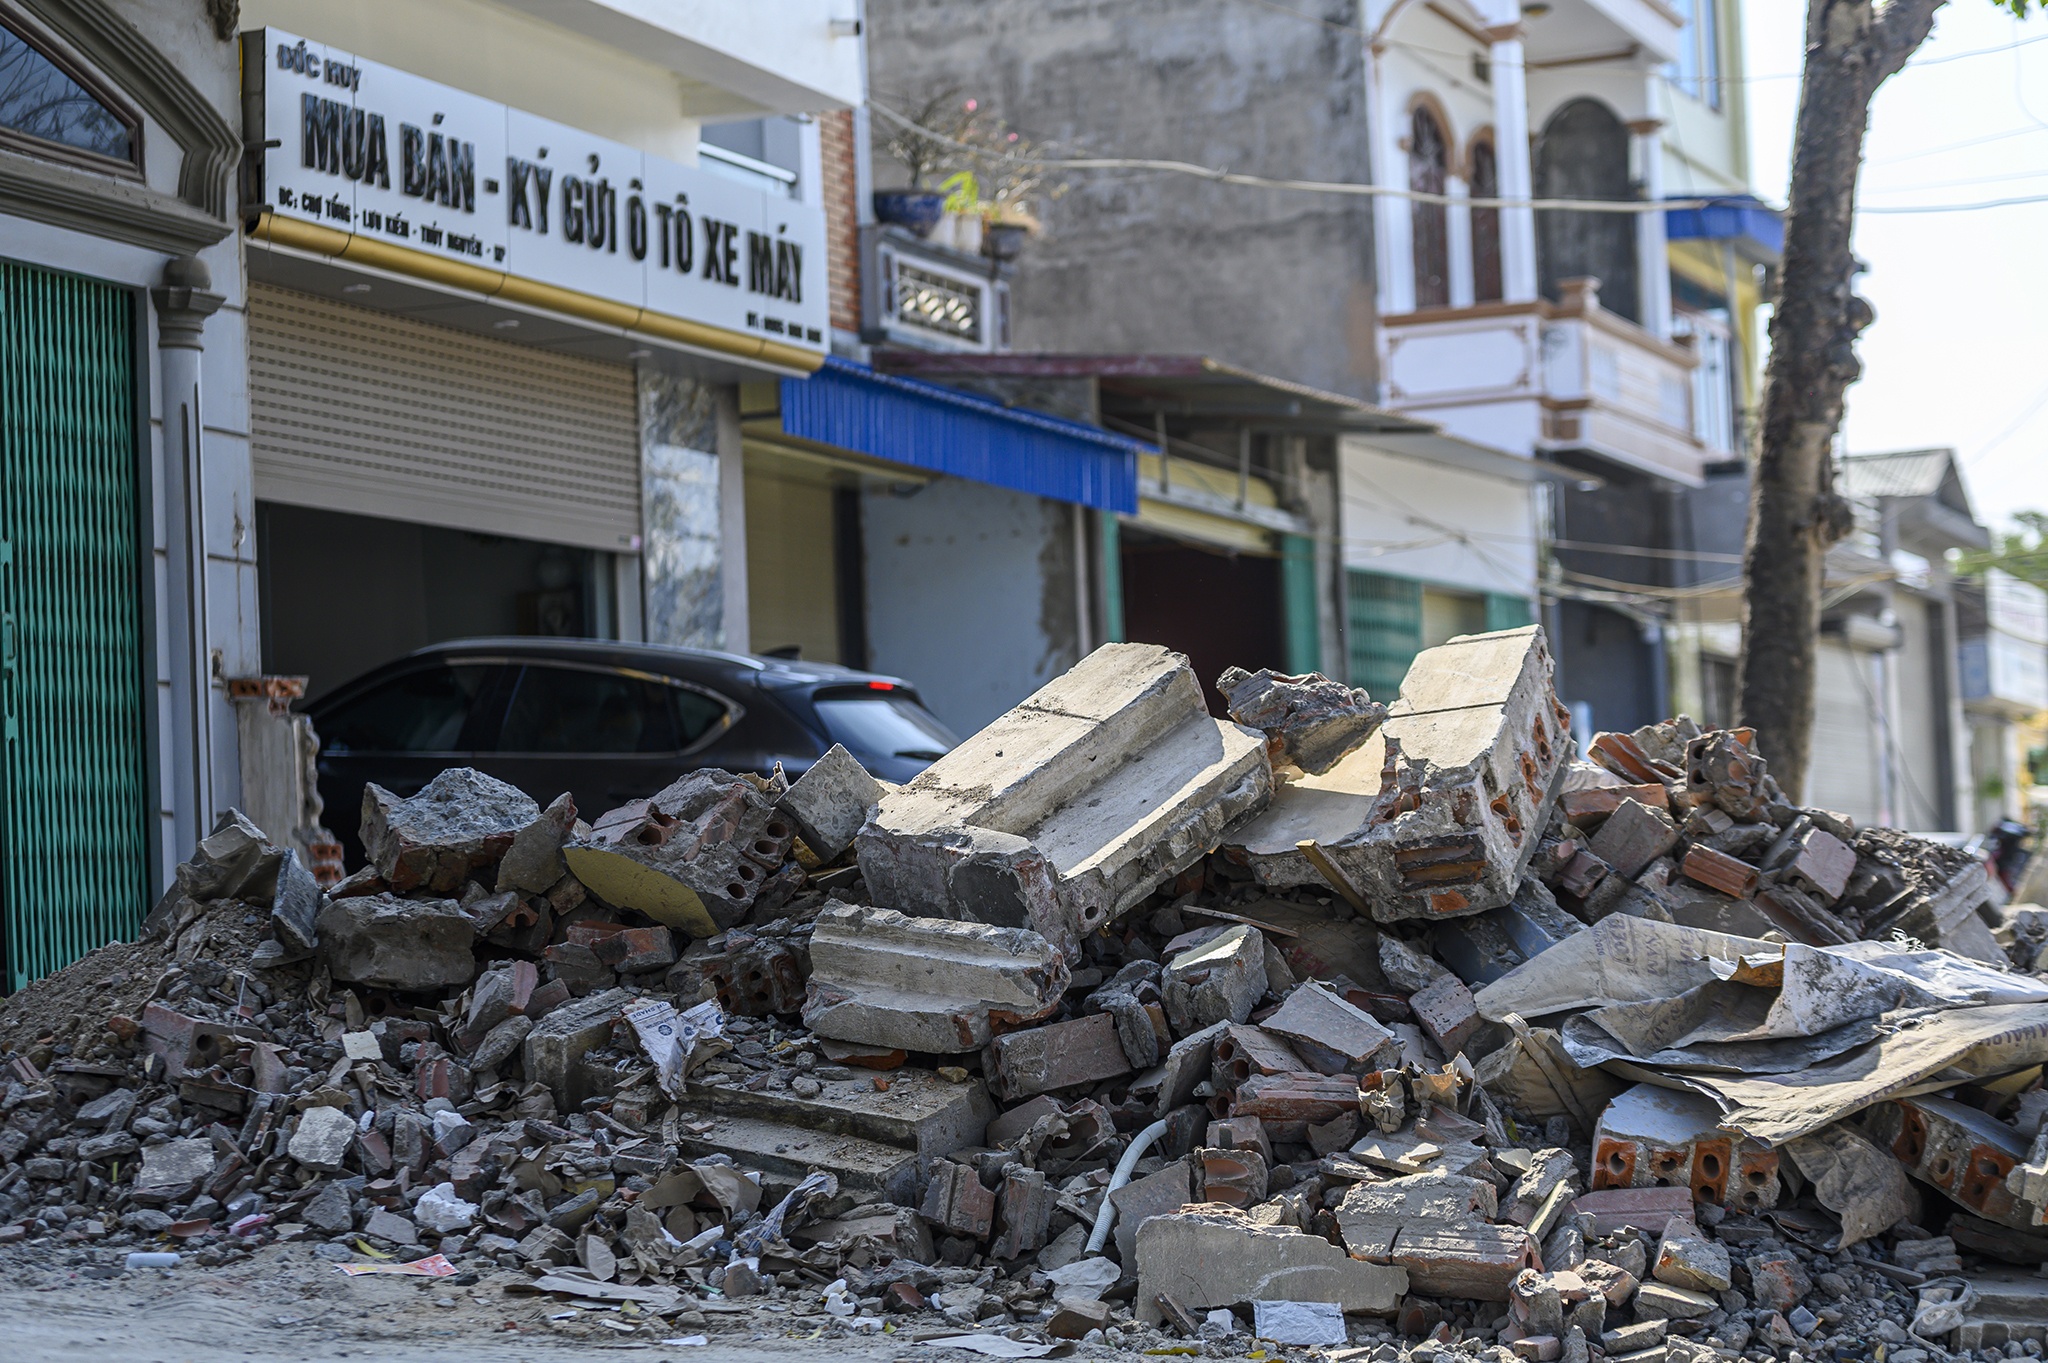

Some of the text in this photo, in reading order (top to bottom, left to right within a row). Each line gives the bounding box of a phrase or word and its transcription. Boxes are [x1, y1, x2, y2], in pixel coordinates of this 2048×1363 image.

[301, 92, 391, 190] MUA
[400, 112, 476, 214] BÁN
[506, 146, 554, 234] KÝ
[561, 153, 617, 254] GỬI
[627, 178, 648, 261] Ô
[655, 191, 693, 274] TÔ
[700, 217, 740, 288] XE
[747, 223, 803, 304] MÁY
